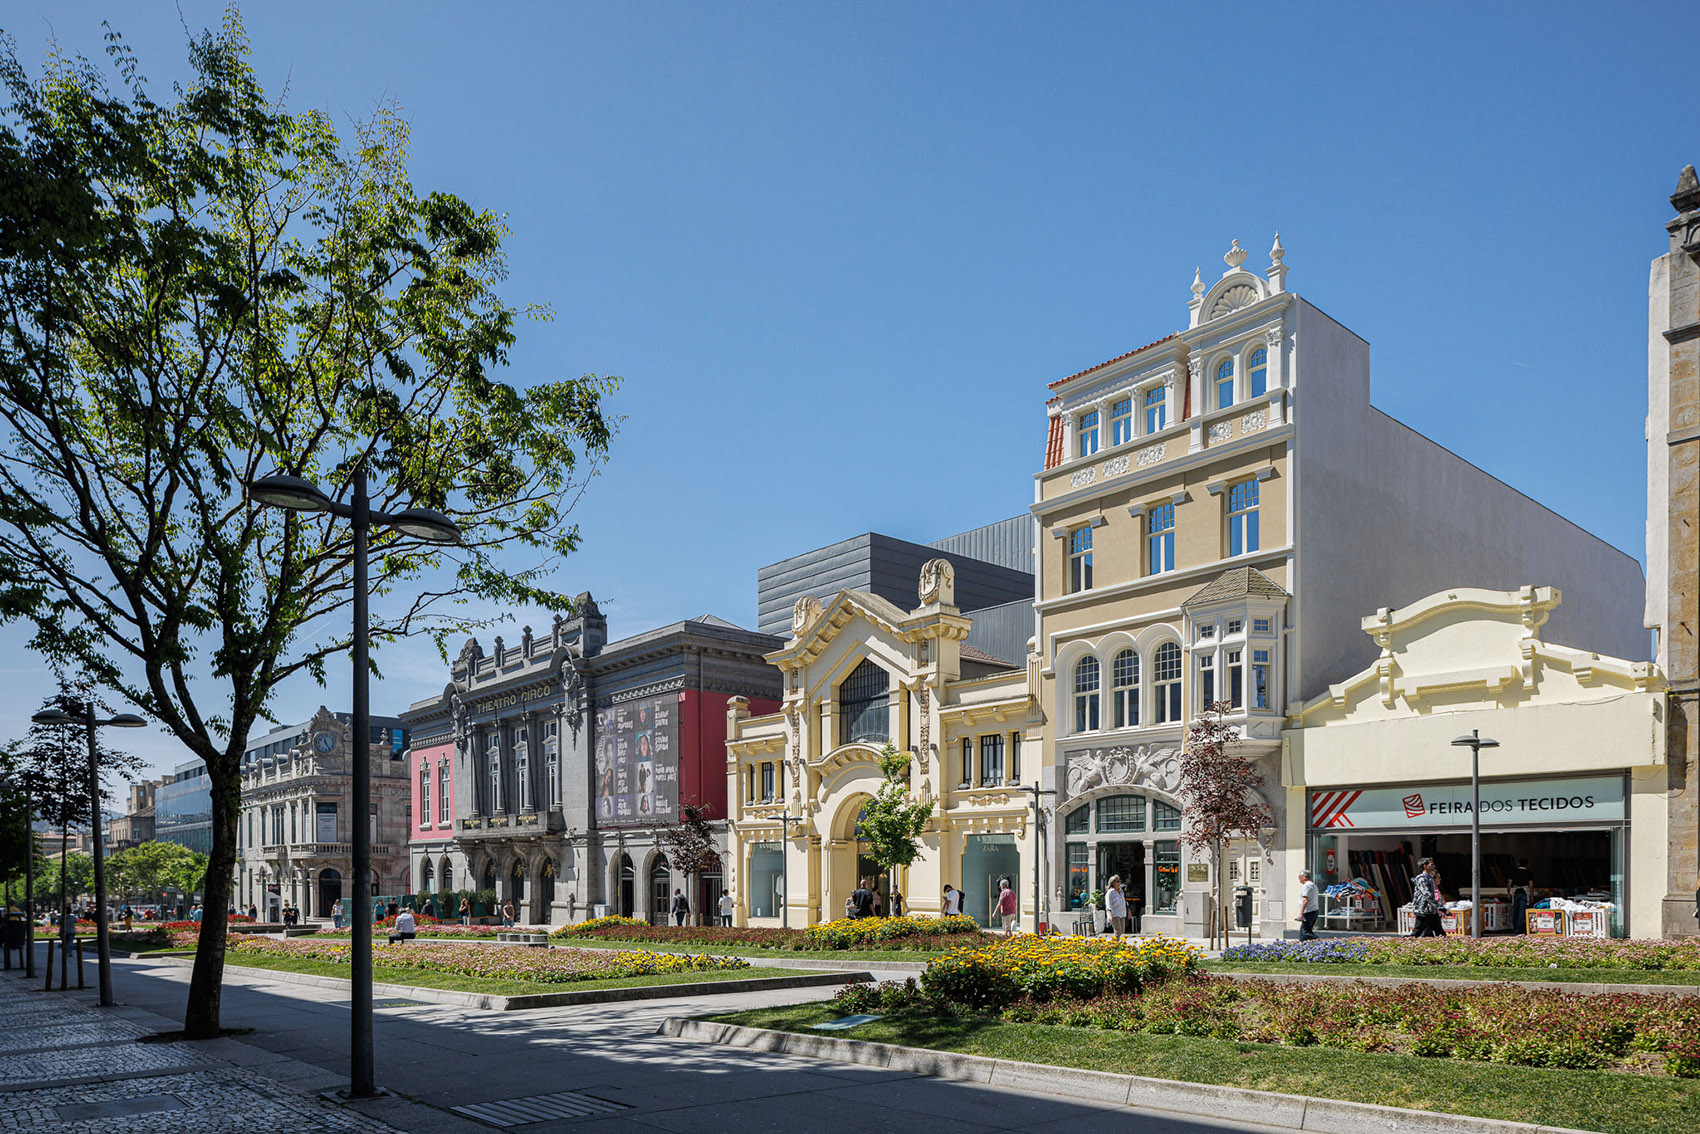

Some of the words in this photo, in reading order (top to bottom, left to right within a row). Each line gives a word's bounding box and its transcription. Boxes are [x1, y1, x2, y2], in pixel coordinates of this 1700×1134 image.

[477, 695, 516, 713] THEATRO
[521, 685, 550, 702] CIRCO
[1430, 801, 1473, 814] FEIRA
[1480, 799, 1513, 813] DOS
[1518, 795, 1594, 811] TECIDOS
